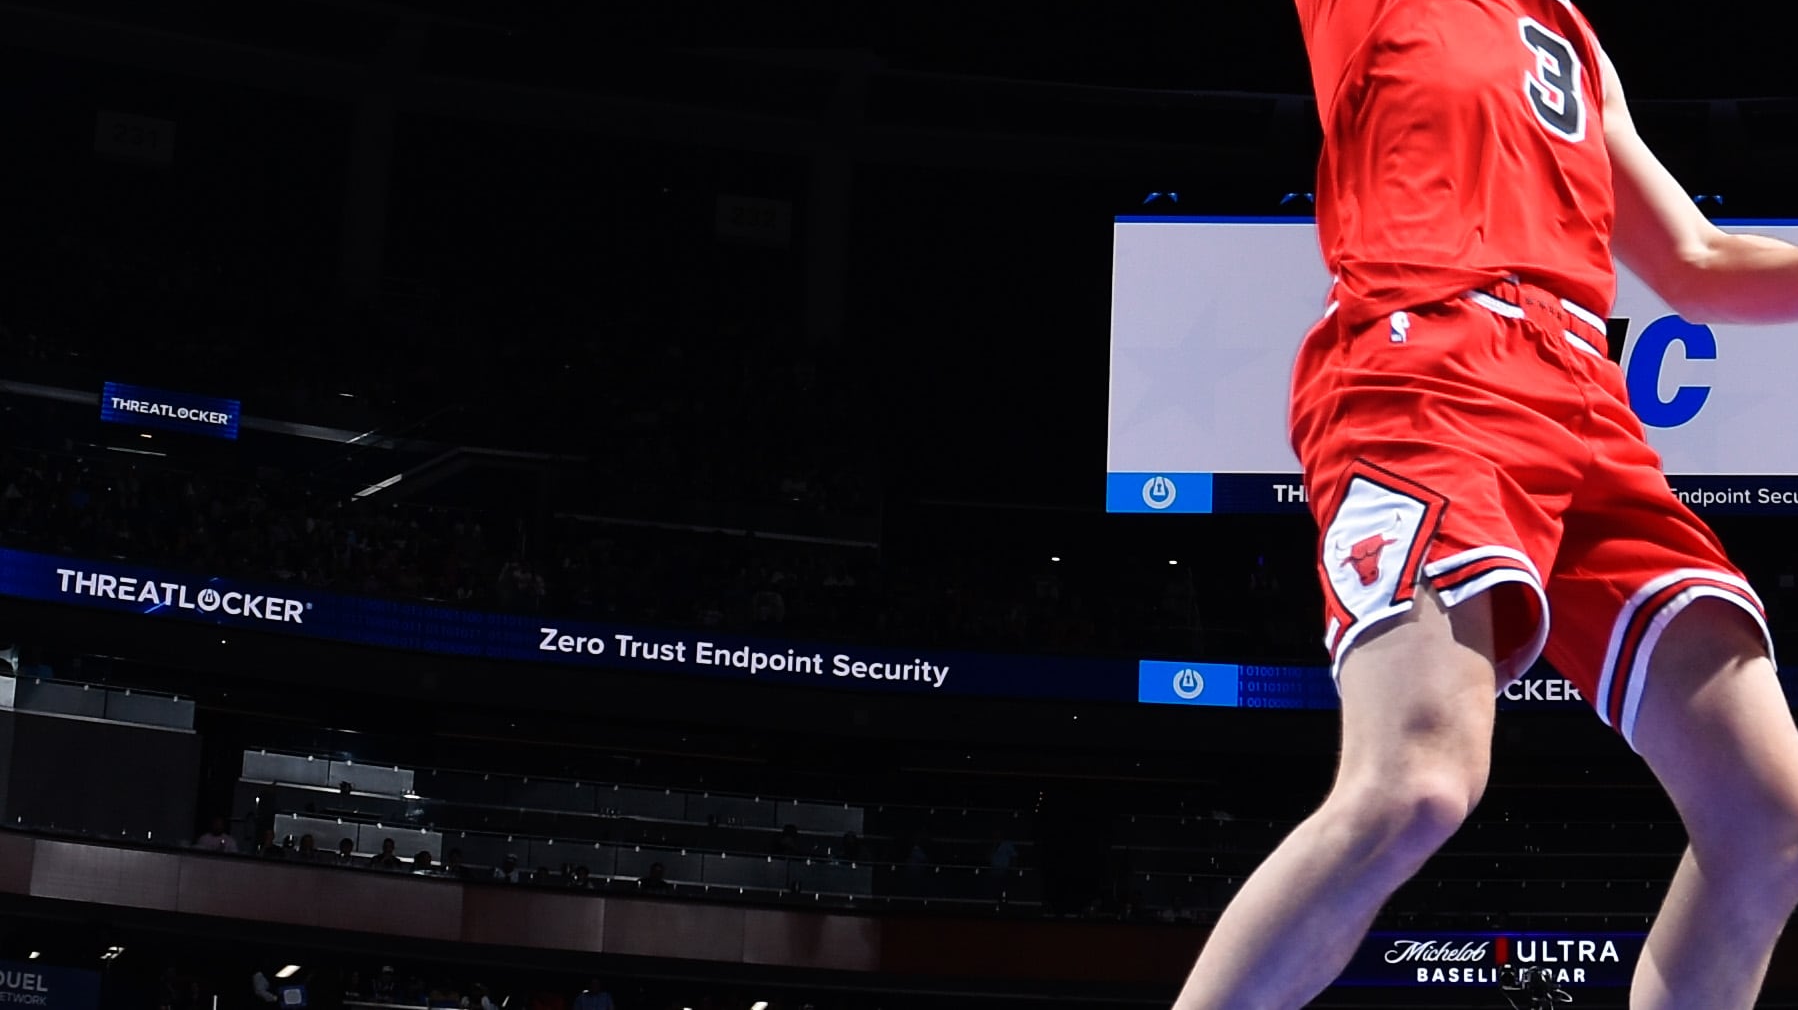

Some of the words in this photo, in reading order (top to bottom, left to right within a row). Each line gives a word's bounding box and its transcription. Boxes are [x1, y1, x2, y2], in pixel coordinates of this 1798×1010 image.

[1517, 15, 1587, 143] 3
[111, 396, 229, 426] THREATLOCKER
[56, 568, 304, 624] THREATLOCKER
[539, 628, 604, 655] Zero
[614, 634, 687, 663] Trust
[696, 642, 824, 675] Endpoint
[832, 654, 950, 688] Security
[1384, 939, 1490, 964] Michelob
[1516, 940, 1620, 963] ULTRA
[1417, 968, 1530, 983] BASELI
